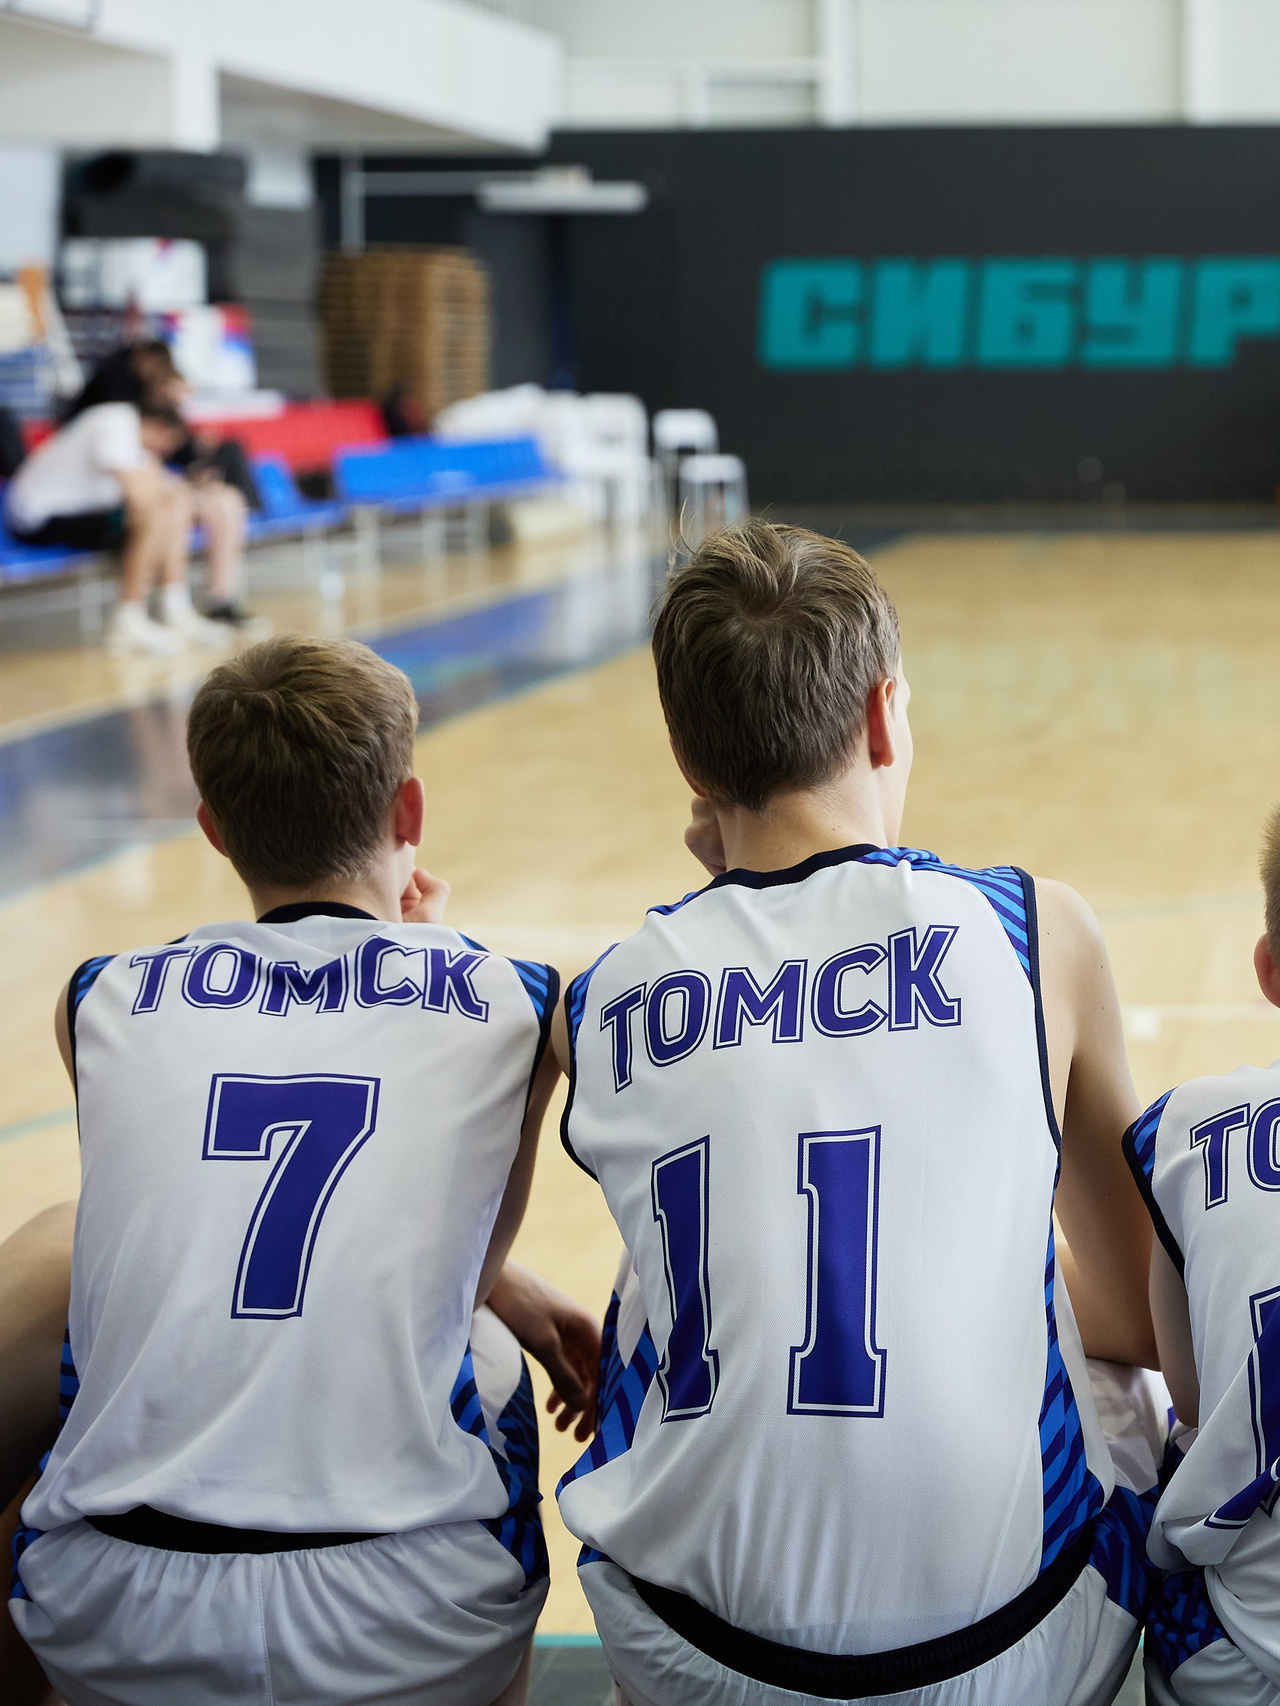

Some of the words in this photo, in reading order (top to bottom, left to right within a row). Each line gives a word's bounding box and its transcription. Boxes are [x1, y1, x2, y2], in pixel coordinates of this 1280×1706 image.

[129, 934, 490, 1023] ТОМСК
[600, 925, 962, 1093] ТОМСК
[201, 1073, 381, 1319] 7
[651, 1124, 887, 1424] 11
